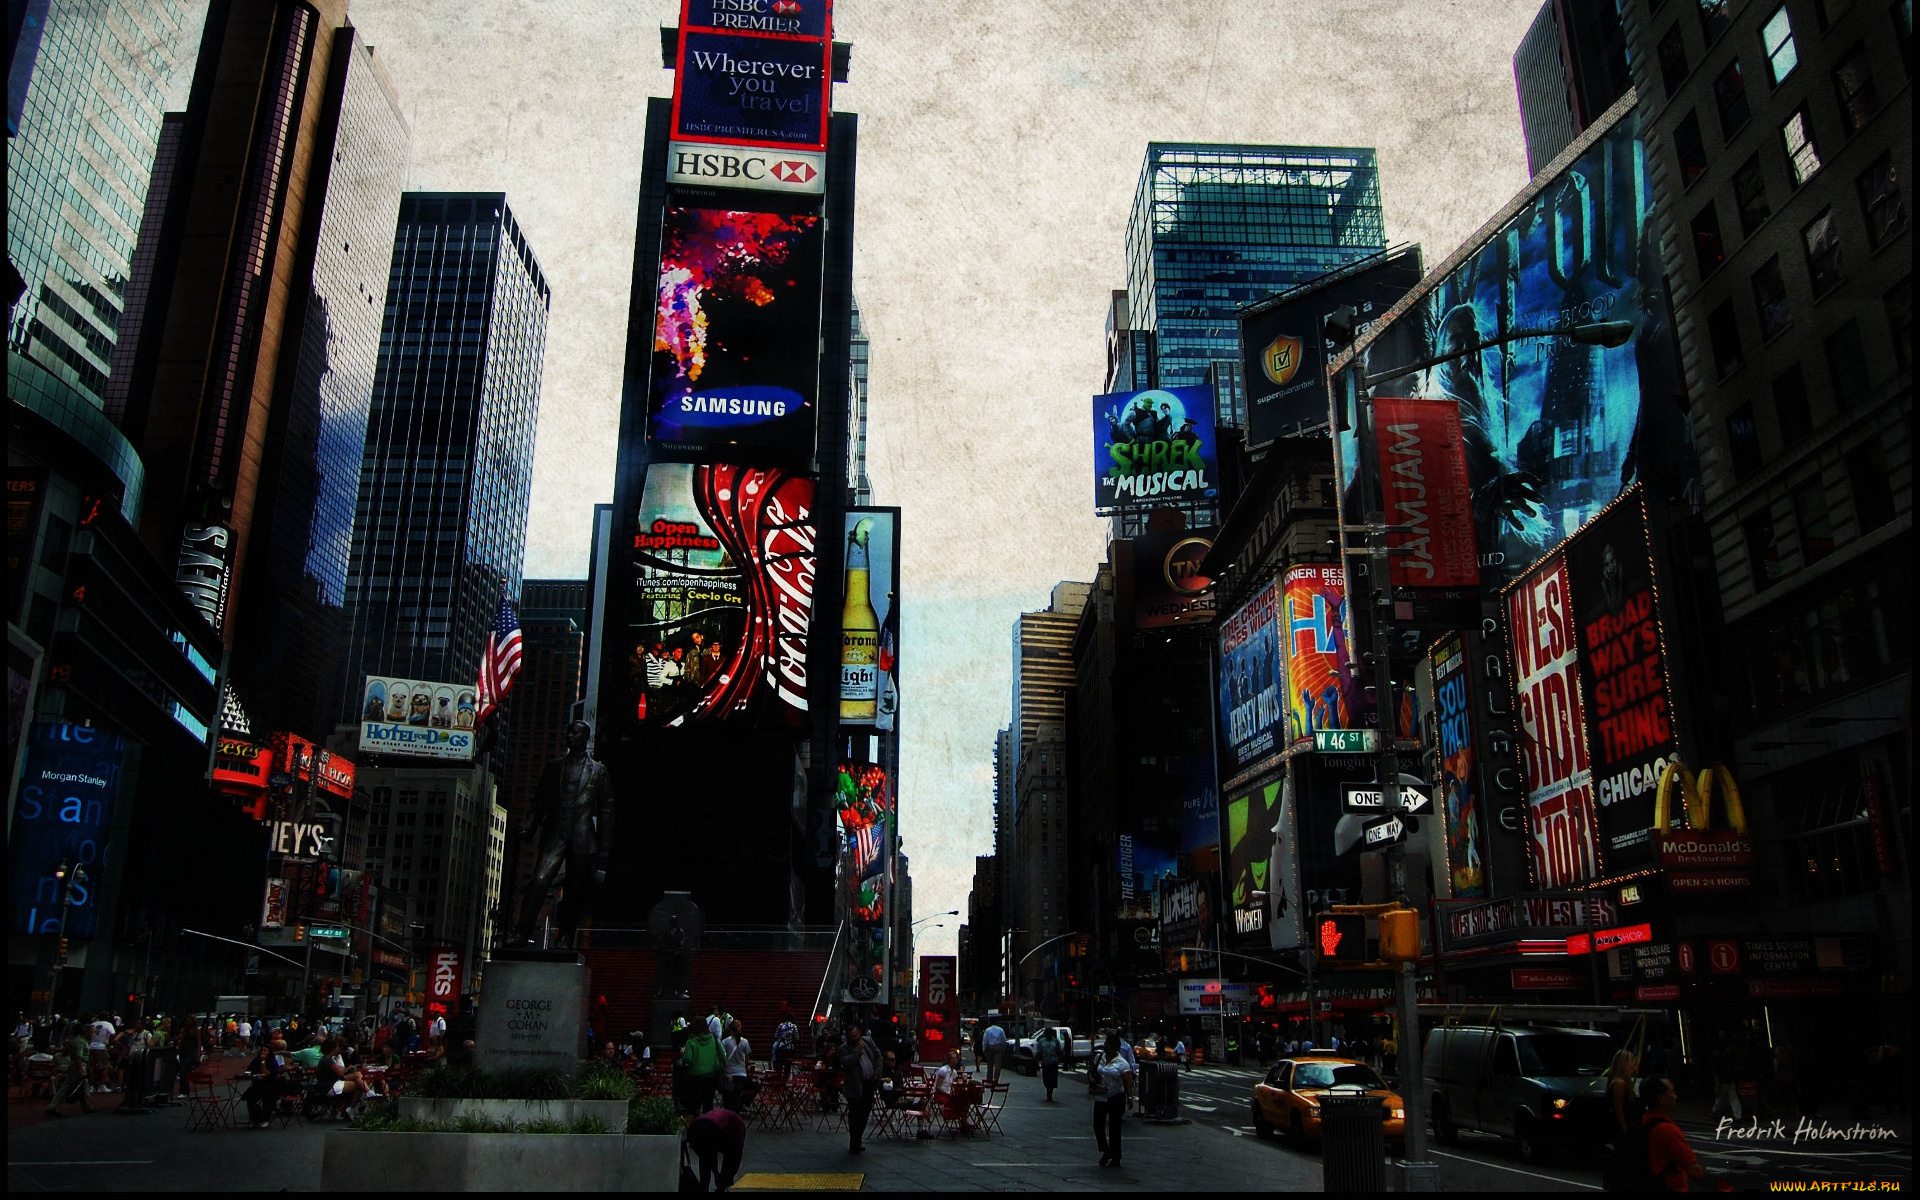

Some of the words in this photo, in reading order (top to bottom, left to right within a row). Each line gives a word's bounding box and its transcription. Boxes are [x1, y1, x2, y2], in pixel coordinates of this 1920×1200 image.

[712, 13, 801, 33] PREMIER
[692, 50, 816, 79] Wherever
[729, 76, 776, 95] you
[741, 94, 811, 114] travel
[674, 152, 766, 180] HSBC
[1257, 378, 1316, 405] superguarantee
[681, 396, 786, 417] SAMSUNG
[1105, 438, 1207, 477] SHREK
[1114, 469, 1209, 500] MUSICAL
[1386, 423, 1435, 580] JAMJAM
[1437, 488, 1455, 538] SQUARE
[652, 520, 697, 535] Open
[633, 534, 719, 549] Happiness
[1457, 502, 1476, 578] CROSSROADS
[1171, 559, 1204, 579] TN
[1442, 540, 1458, 579] TIMES
[636, 578, 737, 590] iTunes.com/openhappiness
[1222, 617, 1240, 638] THE
[1241, 584, 1277, 624] CROWD
[1585, 589, 1653, 651] BROAD
[1223, 629, 1249, 656] GOES
[1249, 602, 1277, 637] WILD!
[841, 635, 877, 647] orona
[1589, 619, 1658, 679] WAY'S
[1594, 652, 1663, 718] SURE
[1229, 695, 1258, 748] JERSEY
[1258, 681, 1280, 724] BOYS
[367, 724, 414, 742] HOTEL
[1597, 694, 1671, 765] THING
[1316, 732, 1326, 750] W
[1330, 732, 1346, 750] 46
[1350, 733, 1360, 741] ST
[1321, 755, 1368, 772] Tonight
[41, 770, 77, 783] Morgan
[78, 773, 107, 788] Stanley
[1184, 798, 1201, 809] PURE
[1355, 793, 1381, 805] ONE
[1401, 793, 1420, 805] AY
[1368, 827, 1382, 842] ONE
[1386, 822, 1401, 838] WAY
[1662, 840, 1751, 854] McDonald's
[1677, 854, 1737, 863] Restaurant
[1672, 878, 1700, 887] OPEN
[1702, 878, 1714, 886] 24
[1717, 877, 1751, 886] HOURS
[1620, 887, 1641, 902] FUEL
[1234, 908, 1263, 935] WICKED
[1450, 911, 1470, 938] WEST
[1469, 906, 1492, 935] SIDE
[1491, 899, 1515, 931] STORY
[1594, 936, 1616, 947] ODY
[1634, 946, 1653, 957] TIMES
[1635, 955, 1671, 968] INFORMATION
[434, 951, 459, 997] tkts
[928, 960, 952, 1005] tkts
[506, 999, 553, 1012] GEORGE
[507, 1019, 548, 1031] COHAN
[523, 1012, 534, 1020] M
